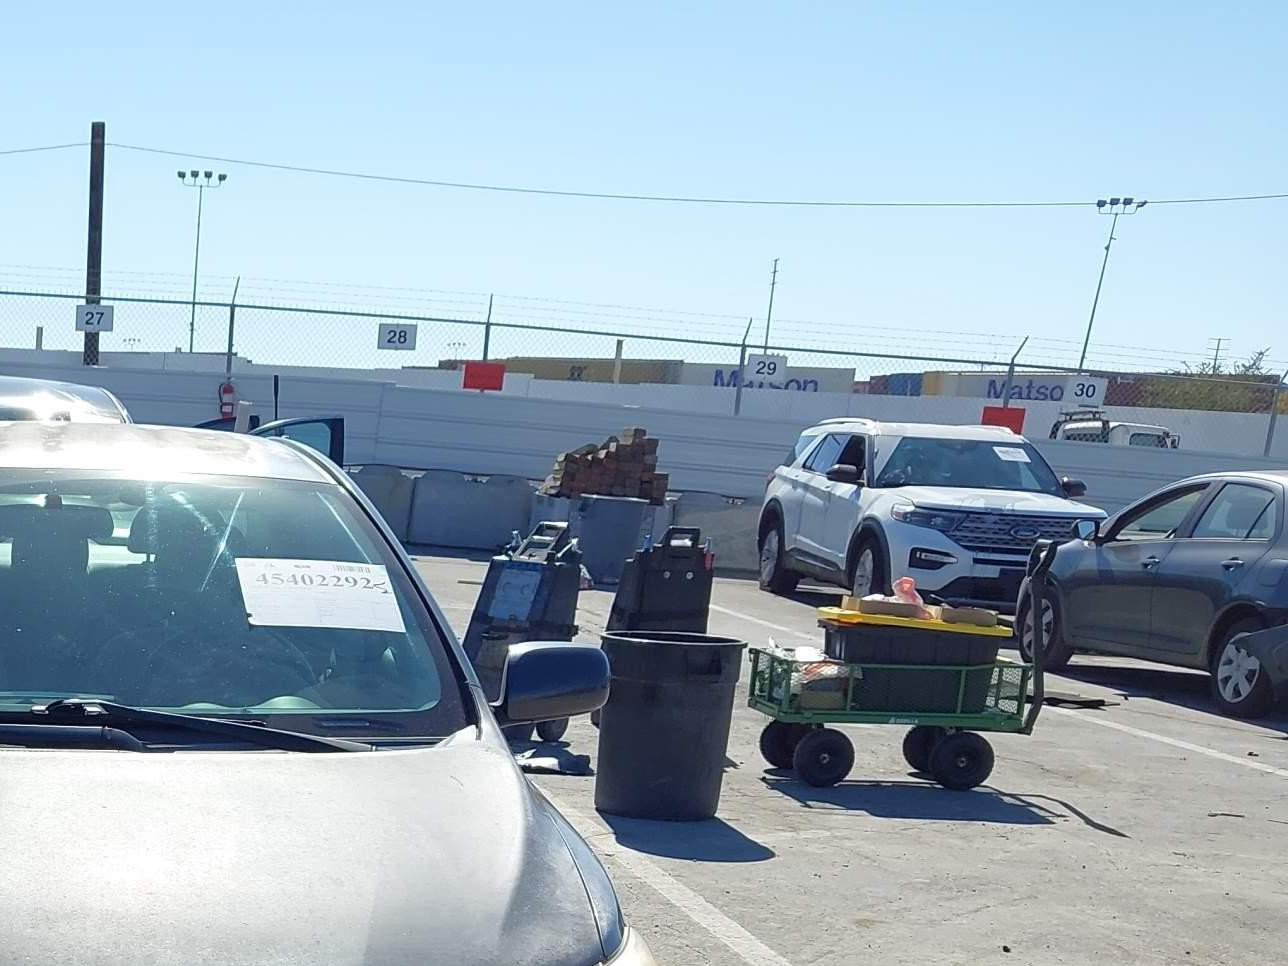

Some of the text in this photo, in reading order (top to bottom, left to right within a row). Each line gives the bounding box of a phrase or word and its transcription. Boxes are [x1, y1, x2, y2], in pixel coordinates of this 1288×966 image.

[84, 311, 105, 326] 27
[386, 329, 408, 345] 28
[755, 360, 777, 376] 29
[986, 378, 1065, 402] Matso
[1073, 382, 1097, 399] 30
[255, 571, 374, 590] 45402292
